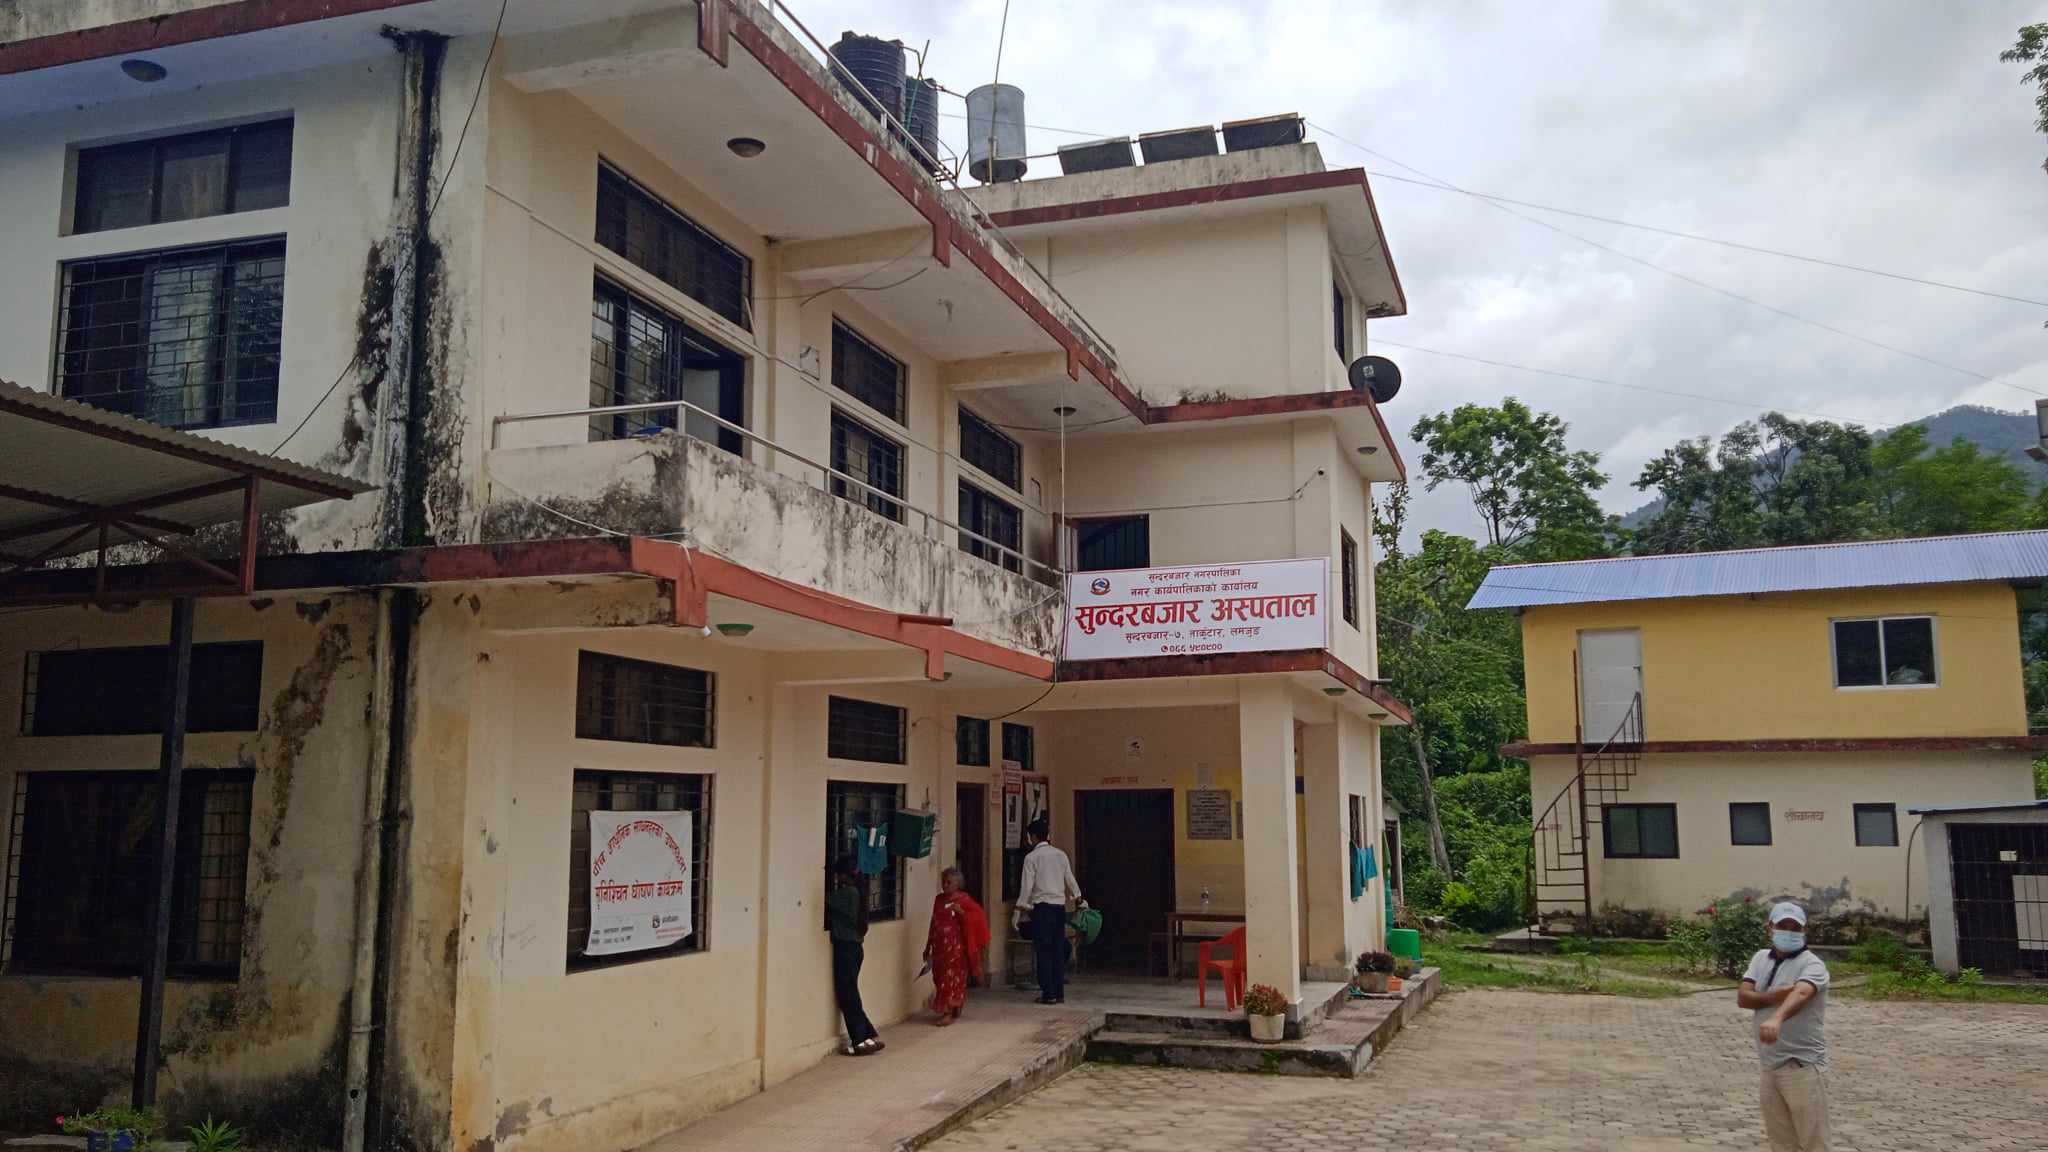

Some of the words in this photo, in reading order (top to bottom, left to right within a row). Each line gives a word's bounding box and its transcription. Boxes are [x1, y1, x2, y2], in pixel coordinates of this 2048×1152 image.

[1194, 568, 1241, 579] नगरपालिका
[1131, 587, 1151, 597] नगर
[1074, 599, 1204, 635] सुन्दरबजार
[1211, 593, 1317, 622] अस्पताल
